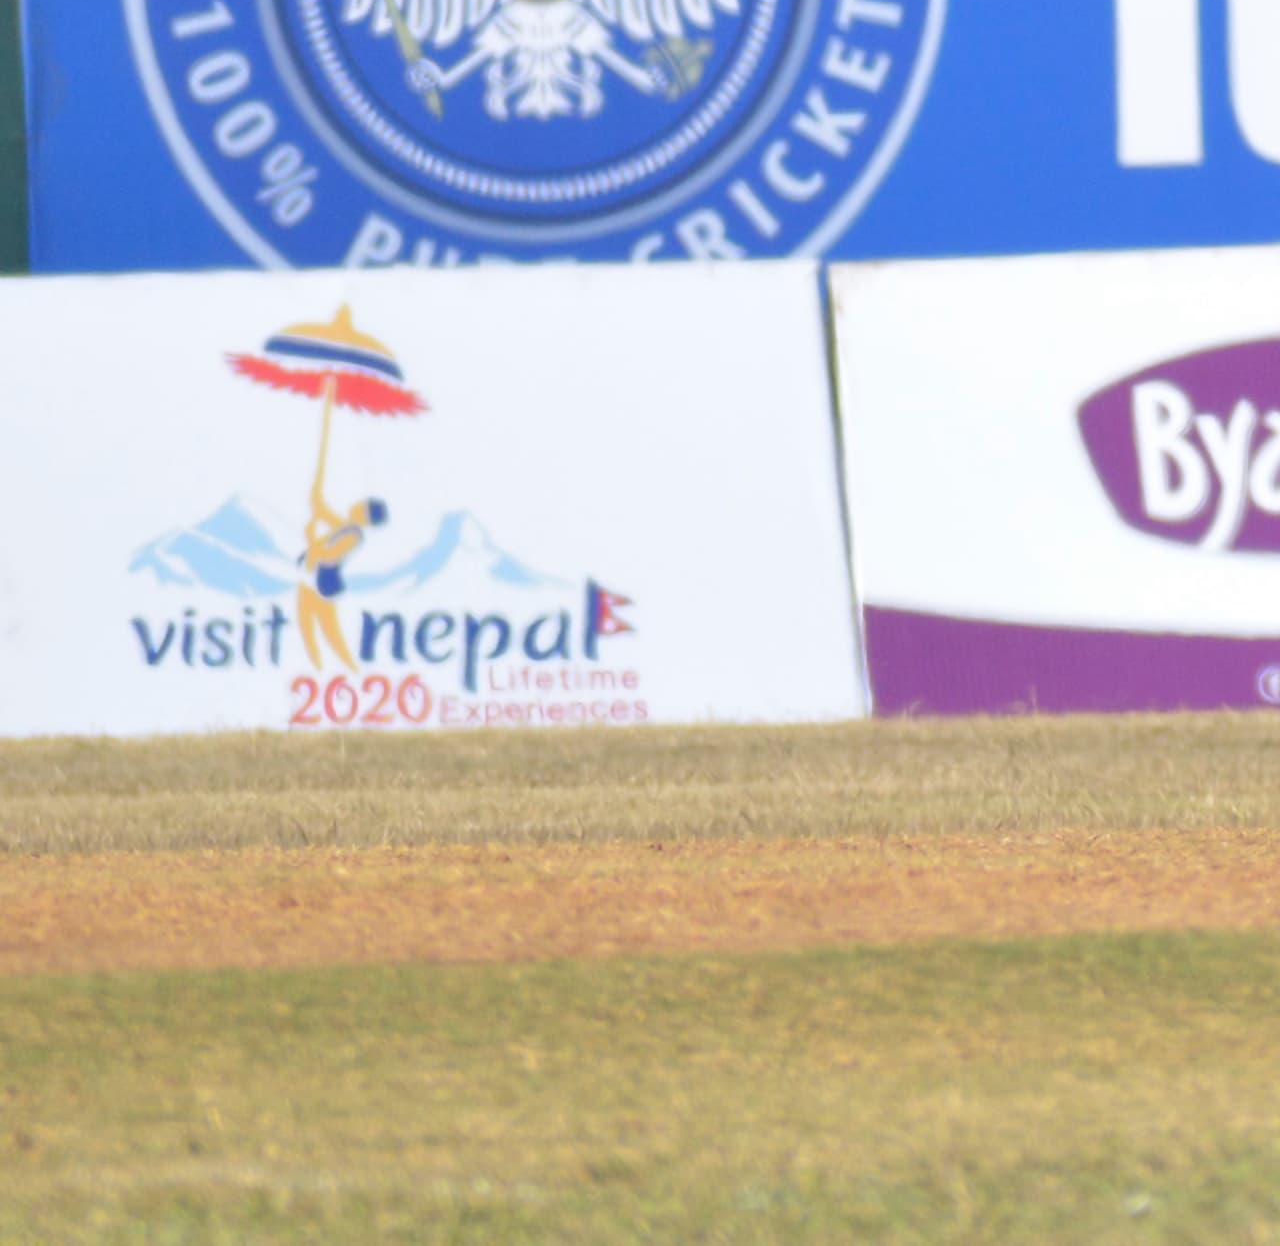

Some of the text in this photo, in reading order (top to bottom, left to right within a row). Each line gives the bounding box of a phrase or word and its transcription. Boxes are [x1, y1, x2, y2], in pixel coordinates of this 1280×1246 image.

[171, 0, 317, 227] 100%
[131, 579, 600, 692] visit nepal
[289, 673, 432, 725] 2020
[488, 664, 640, 691] Lifetime
[439, 695, 648, 725] Experiences
